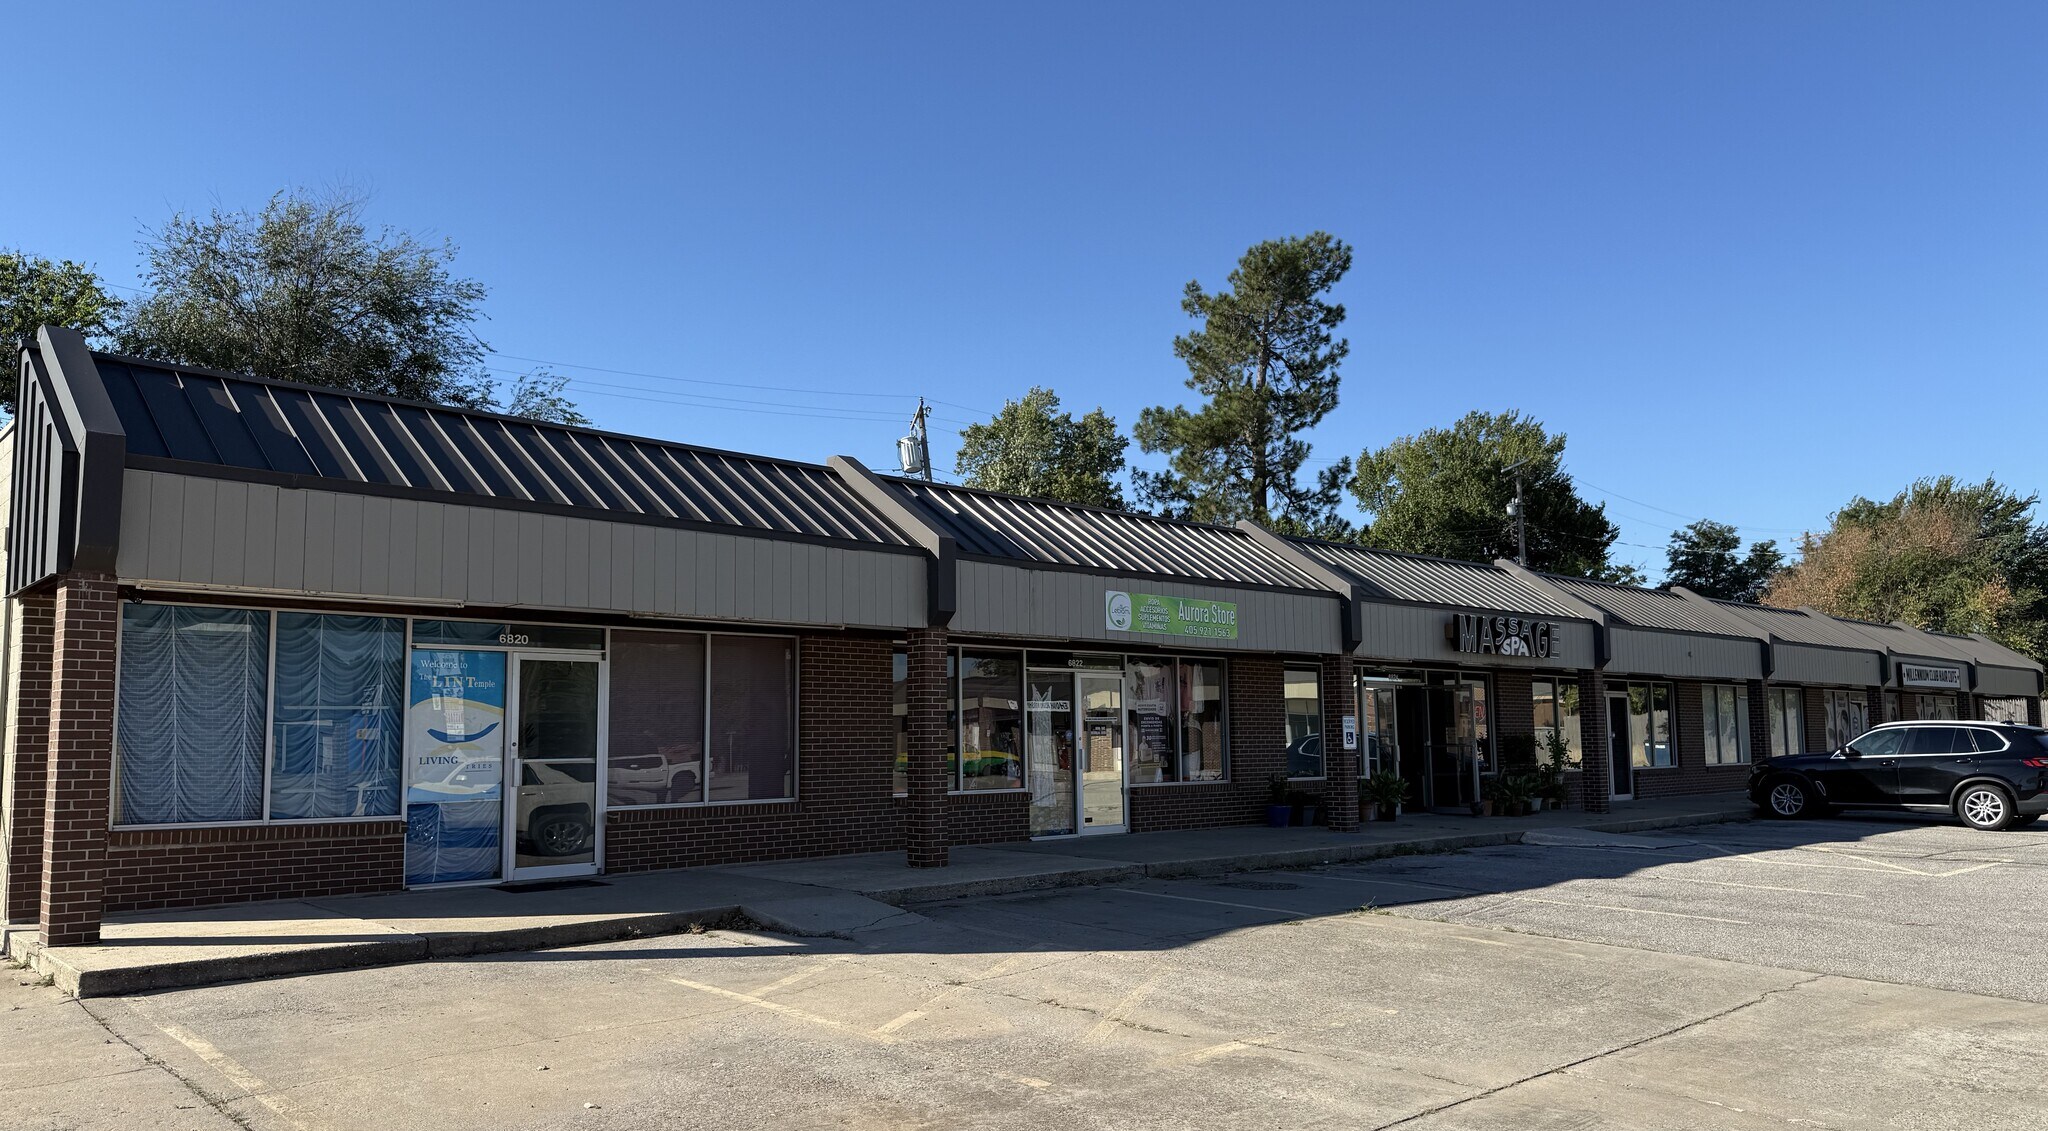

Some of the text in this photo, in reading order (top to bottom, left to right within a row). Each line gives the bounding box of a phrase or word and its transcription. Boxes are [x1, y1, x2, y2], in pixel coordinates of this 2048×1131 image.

[1178, 601, 1235, 625] Aurora Store
[1184, 625, 1198, 635] 405
[1199, 626, 1212, 636] 921
[1458, 613, 1560, 659] MASSAGE
[499, 634, 529, 645] 6820
[1500, 636, 1531, 656] SPA
[420, 659, 468, 669] Welcome to
[1067, 659, 1084, 667] 6822
[419, 673, 431, 681] The
[419, 756, 459, 765] LIVING
